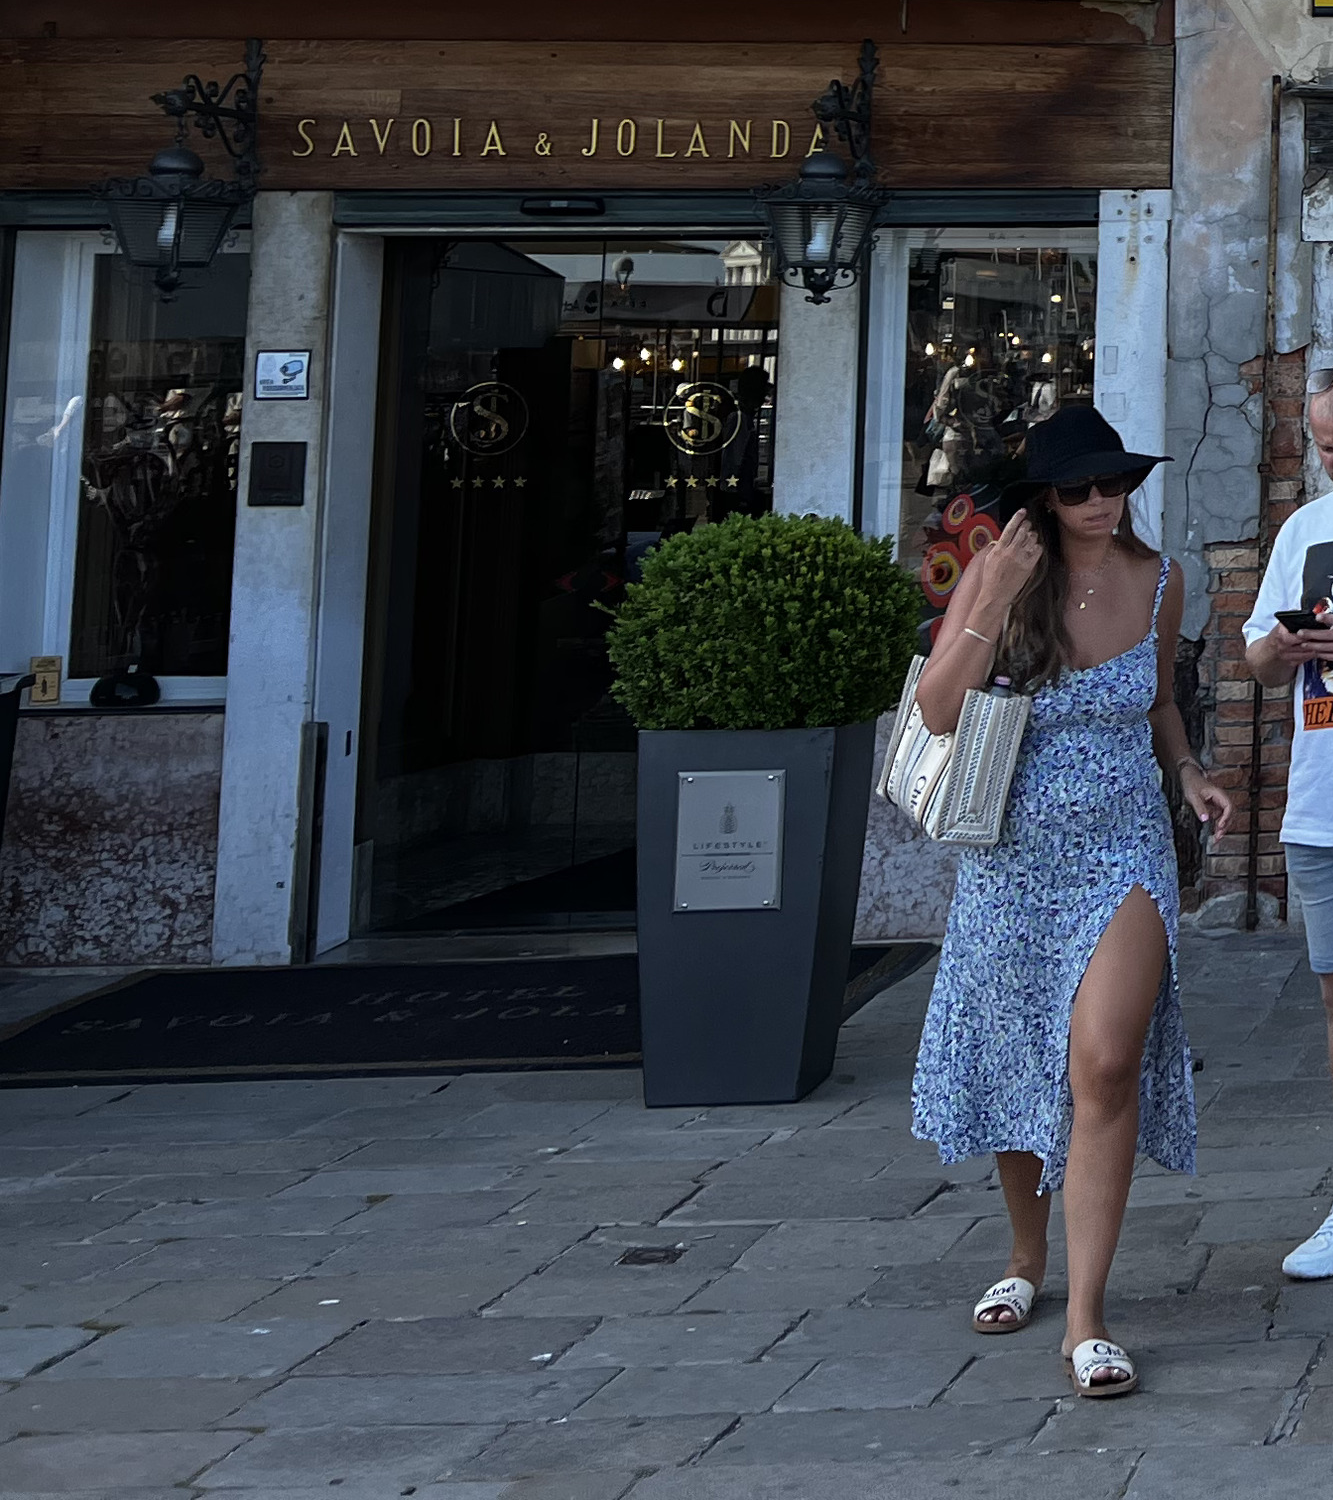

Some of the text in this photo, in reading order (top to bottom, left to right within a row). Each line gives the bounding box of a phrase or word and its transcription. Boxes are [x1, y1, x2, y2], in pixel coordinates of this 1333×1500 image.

[292, 118, 826, 158] SAVOIA & JOLANDA
[450, 1003, 627, 1021] JOLA
